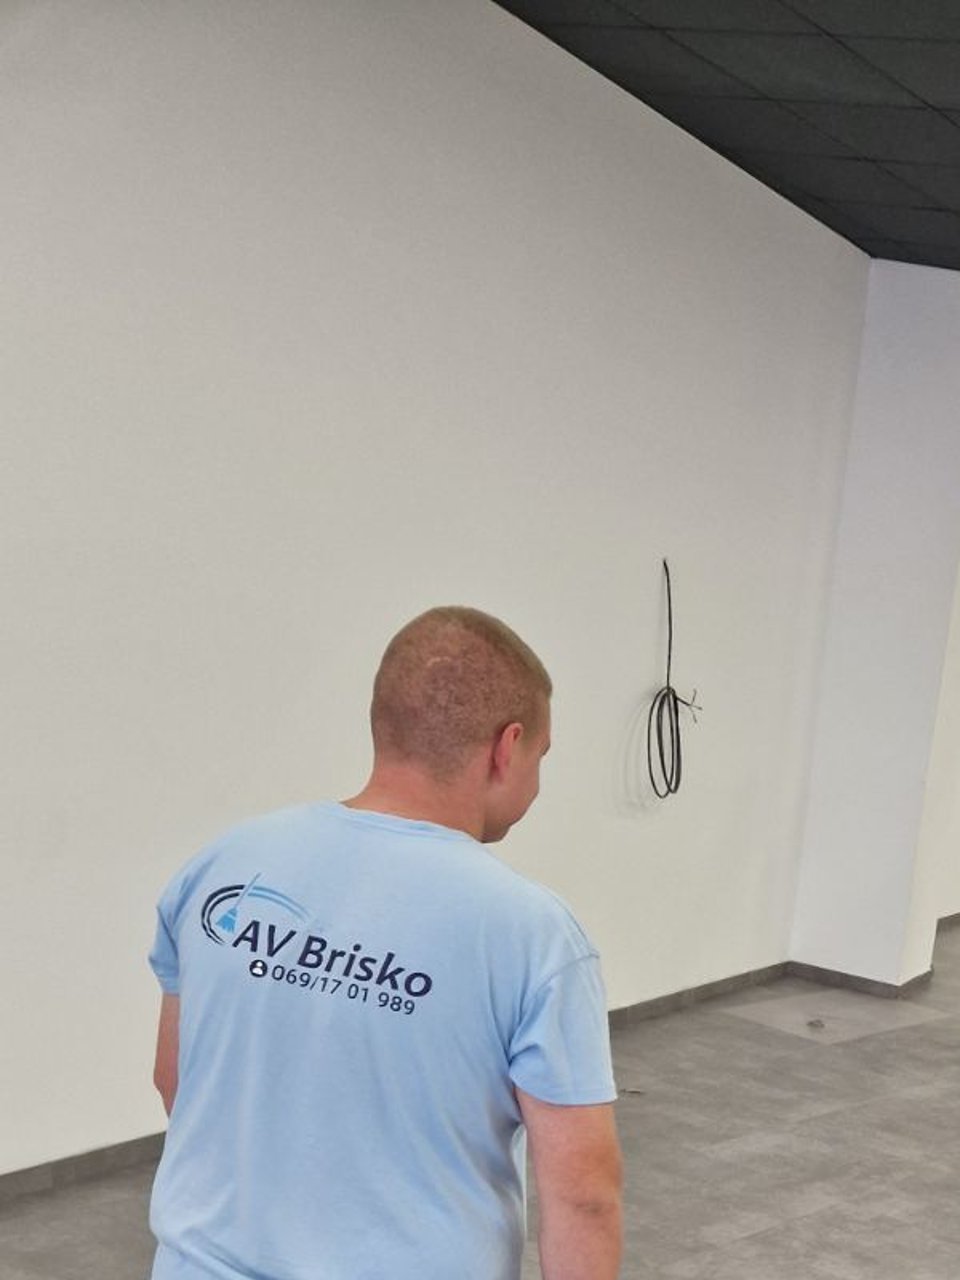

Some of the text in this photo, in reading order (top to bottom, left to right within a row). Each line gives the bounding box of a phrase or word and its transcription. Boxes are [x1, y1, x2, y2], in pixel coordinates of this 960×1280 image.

[232, 919, 433, 998] AV Brisko
[271, 964, 416, 1016] 069/17 01 989
